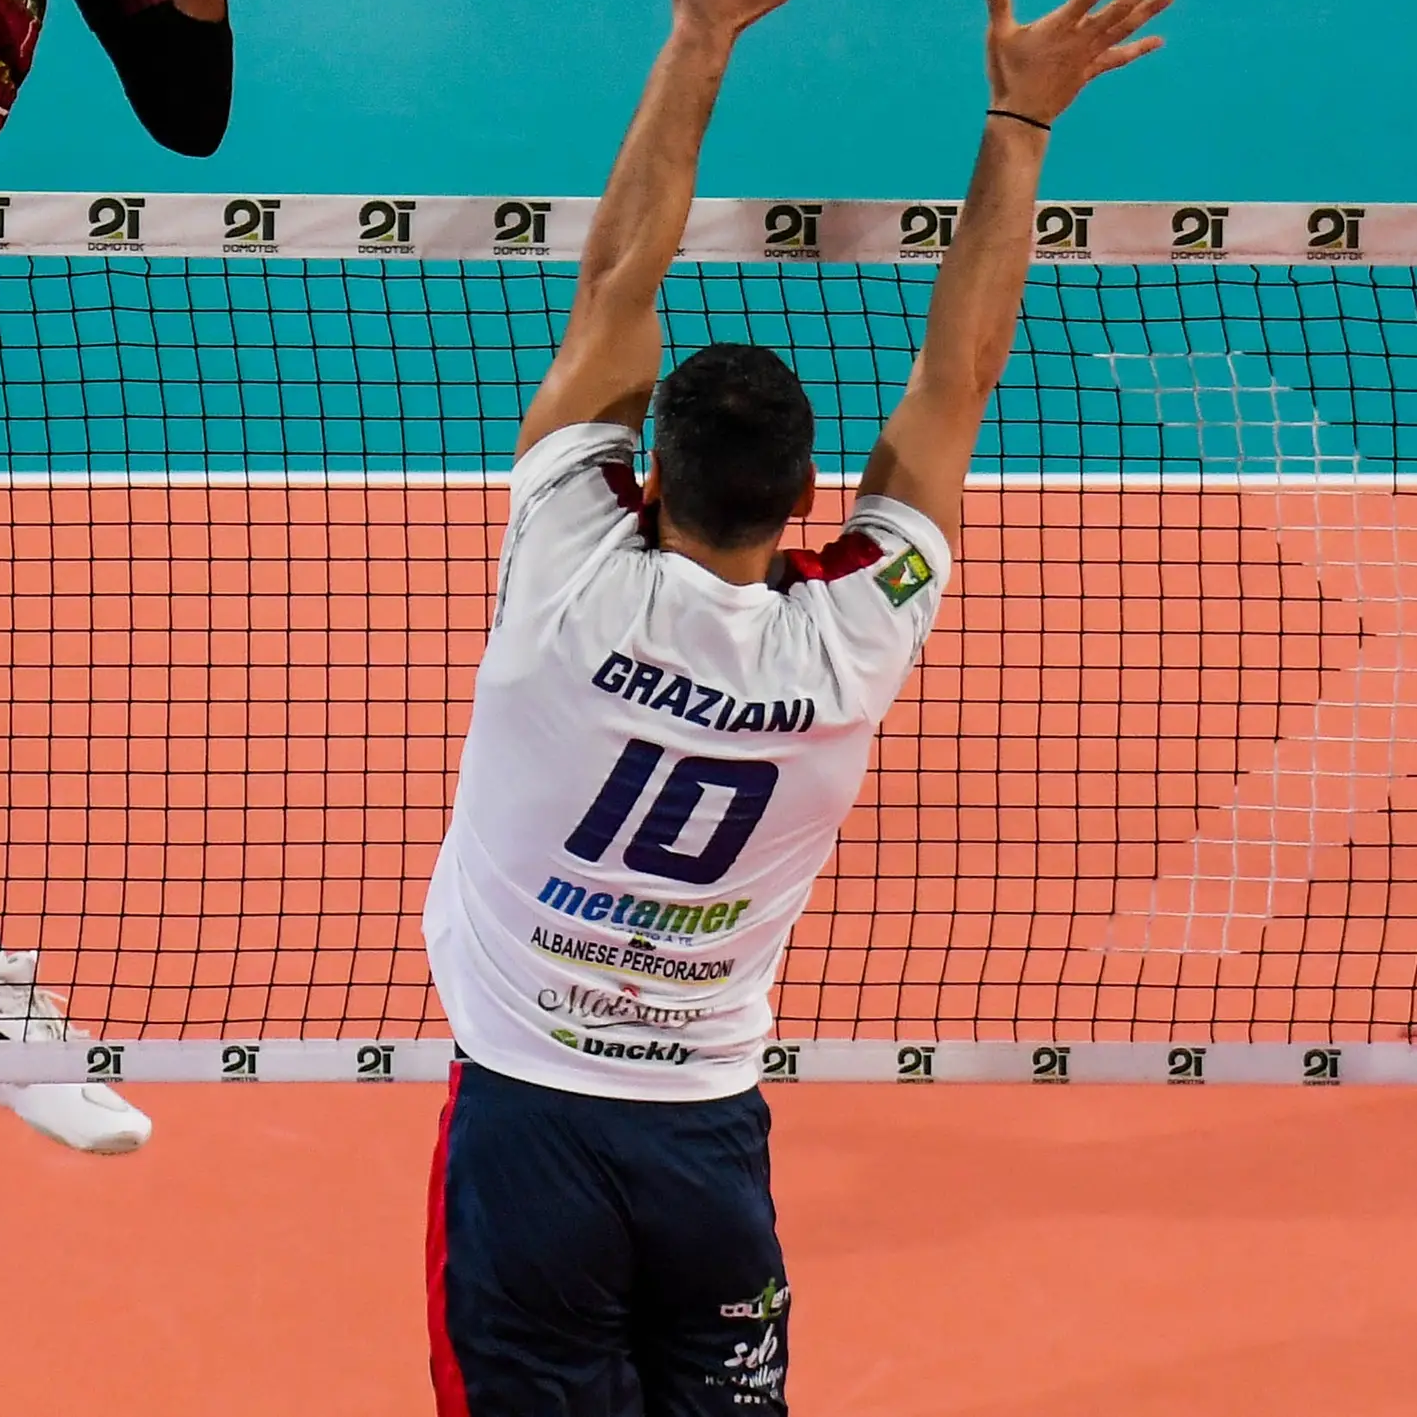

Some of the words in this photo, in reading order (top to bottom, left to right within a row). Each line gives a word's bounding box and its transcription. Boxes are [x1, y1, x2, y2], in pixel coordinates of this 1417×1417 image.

[902, 250, 944, 259] DOMOT
[591, 650, 816, 733] GRAZIANI
[564, 738, 779, 884] 10
[537, 876, 752, 934] metamer
[530, 926, 619, 967] ALBANESE
[620, 949, 735, 981] PERFORAZIONI
